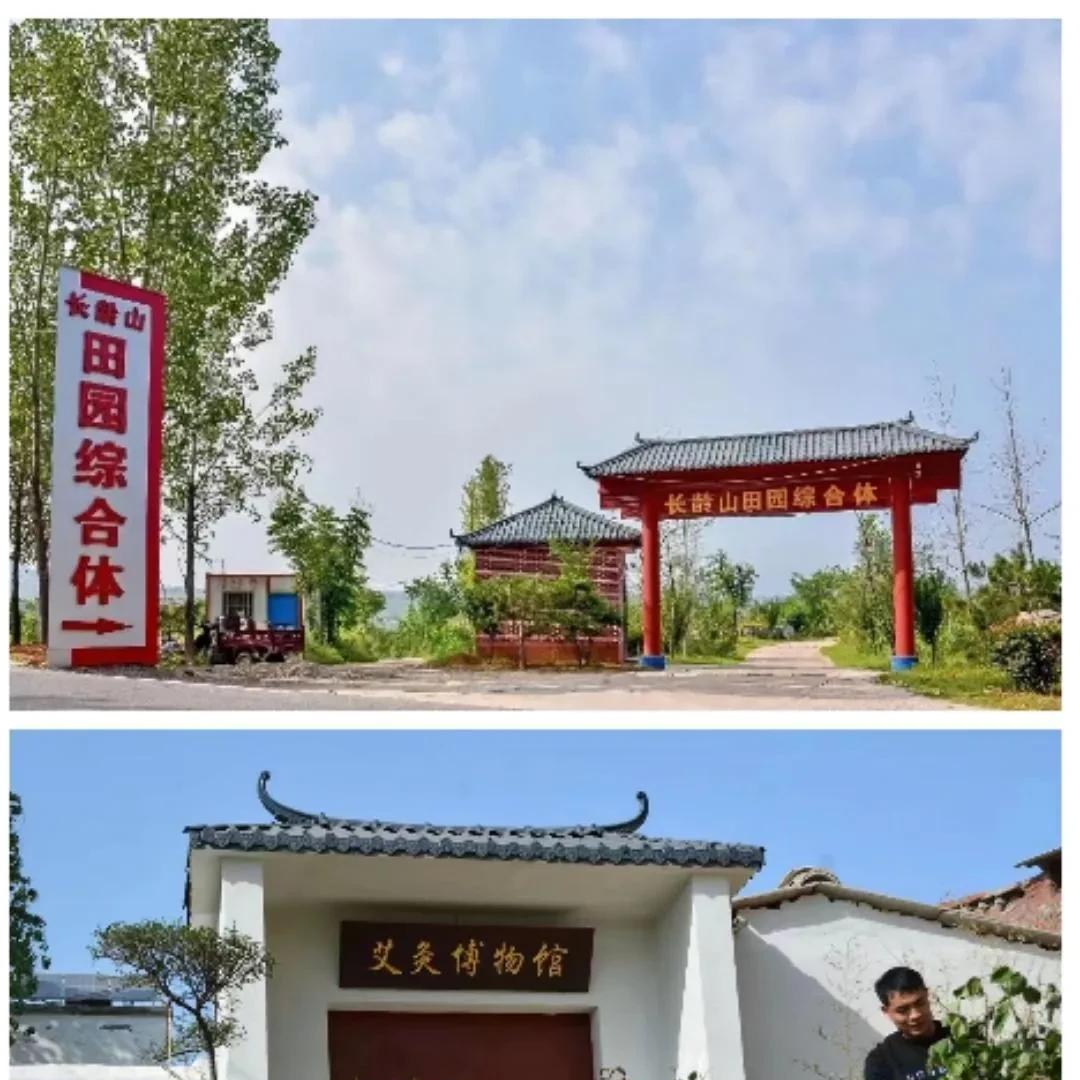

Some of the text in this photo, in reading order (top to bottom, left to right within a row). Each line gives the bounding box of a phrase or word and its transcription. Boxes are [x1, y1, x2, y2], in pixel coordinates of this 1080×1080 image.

[70, 330, 128, 606] 田园综合体
[663, 480, 878, 516] 长龄山田园综合体
[369, 938, 569, 977] 艾灸博物馆
